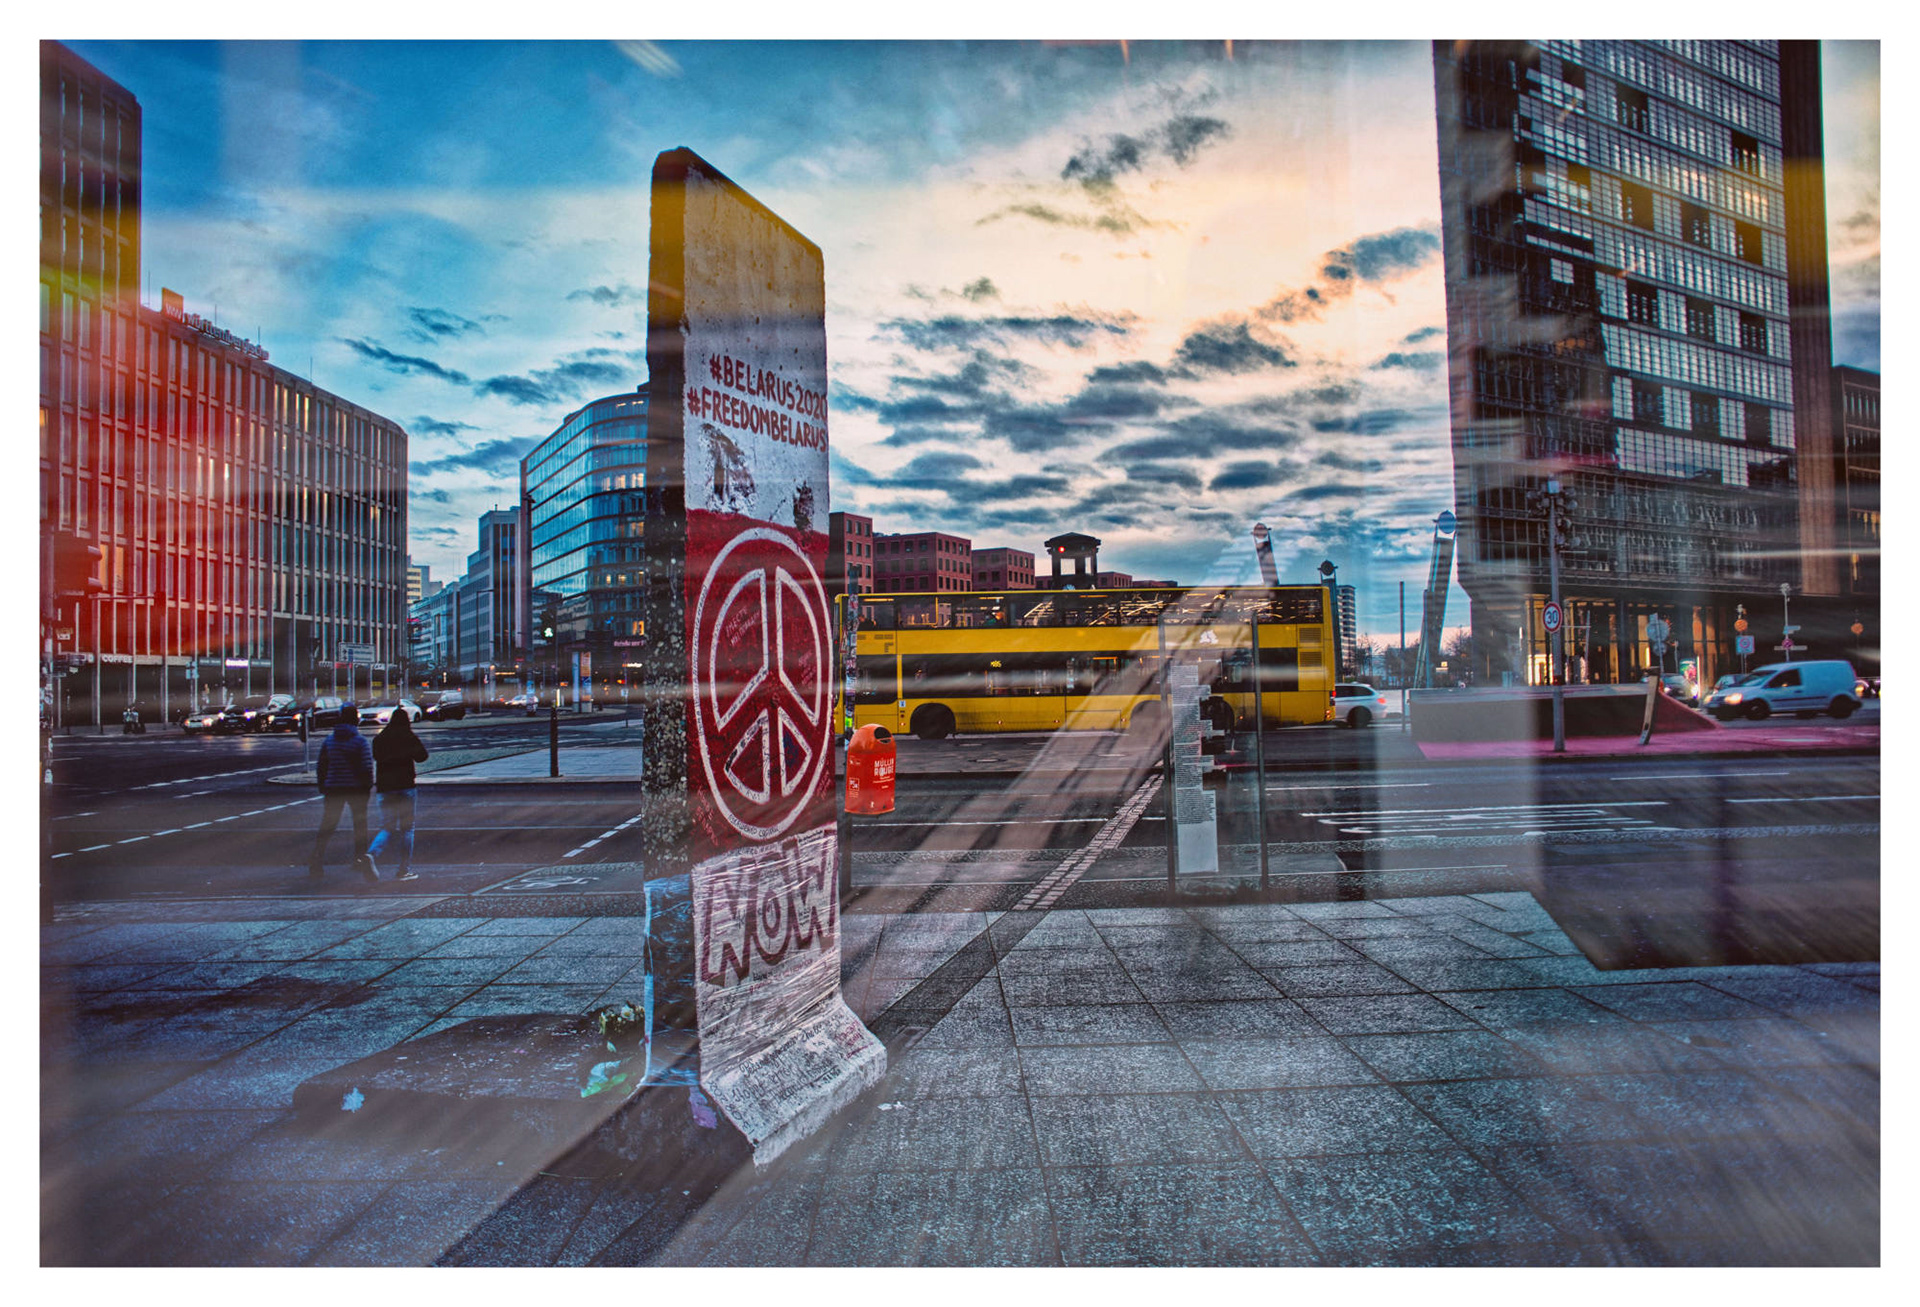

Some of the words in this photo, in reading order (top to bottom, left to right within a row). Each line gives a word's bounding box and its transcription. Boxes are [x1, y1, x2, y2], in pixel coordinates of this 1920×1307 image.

[687, 386, 827, 452] #FREEDOMBELARUS
[1546, 610, 1558, 625] 30
[101, 654, 134, 664] COFFEE
[700, 831, 838, 987] NOW
